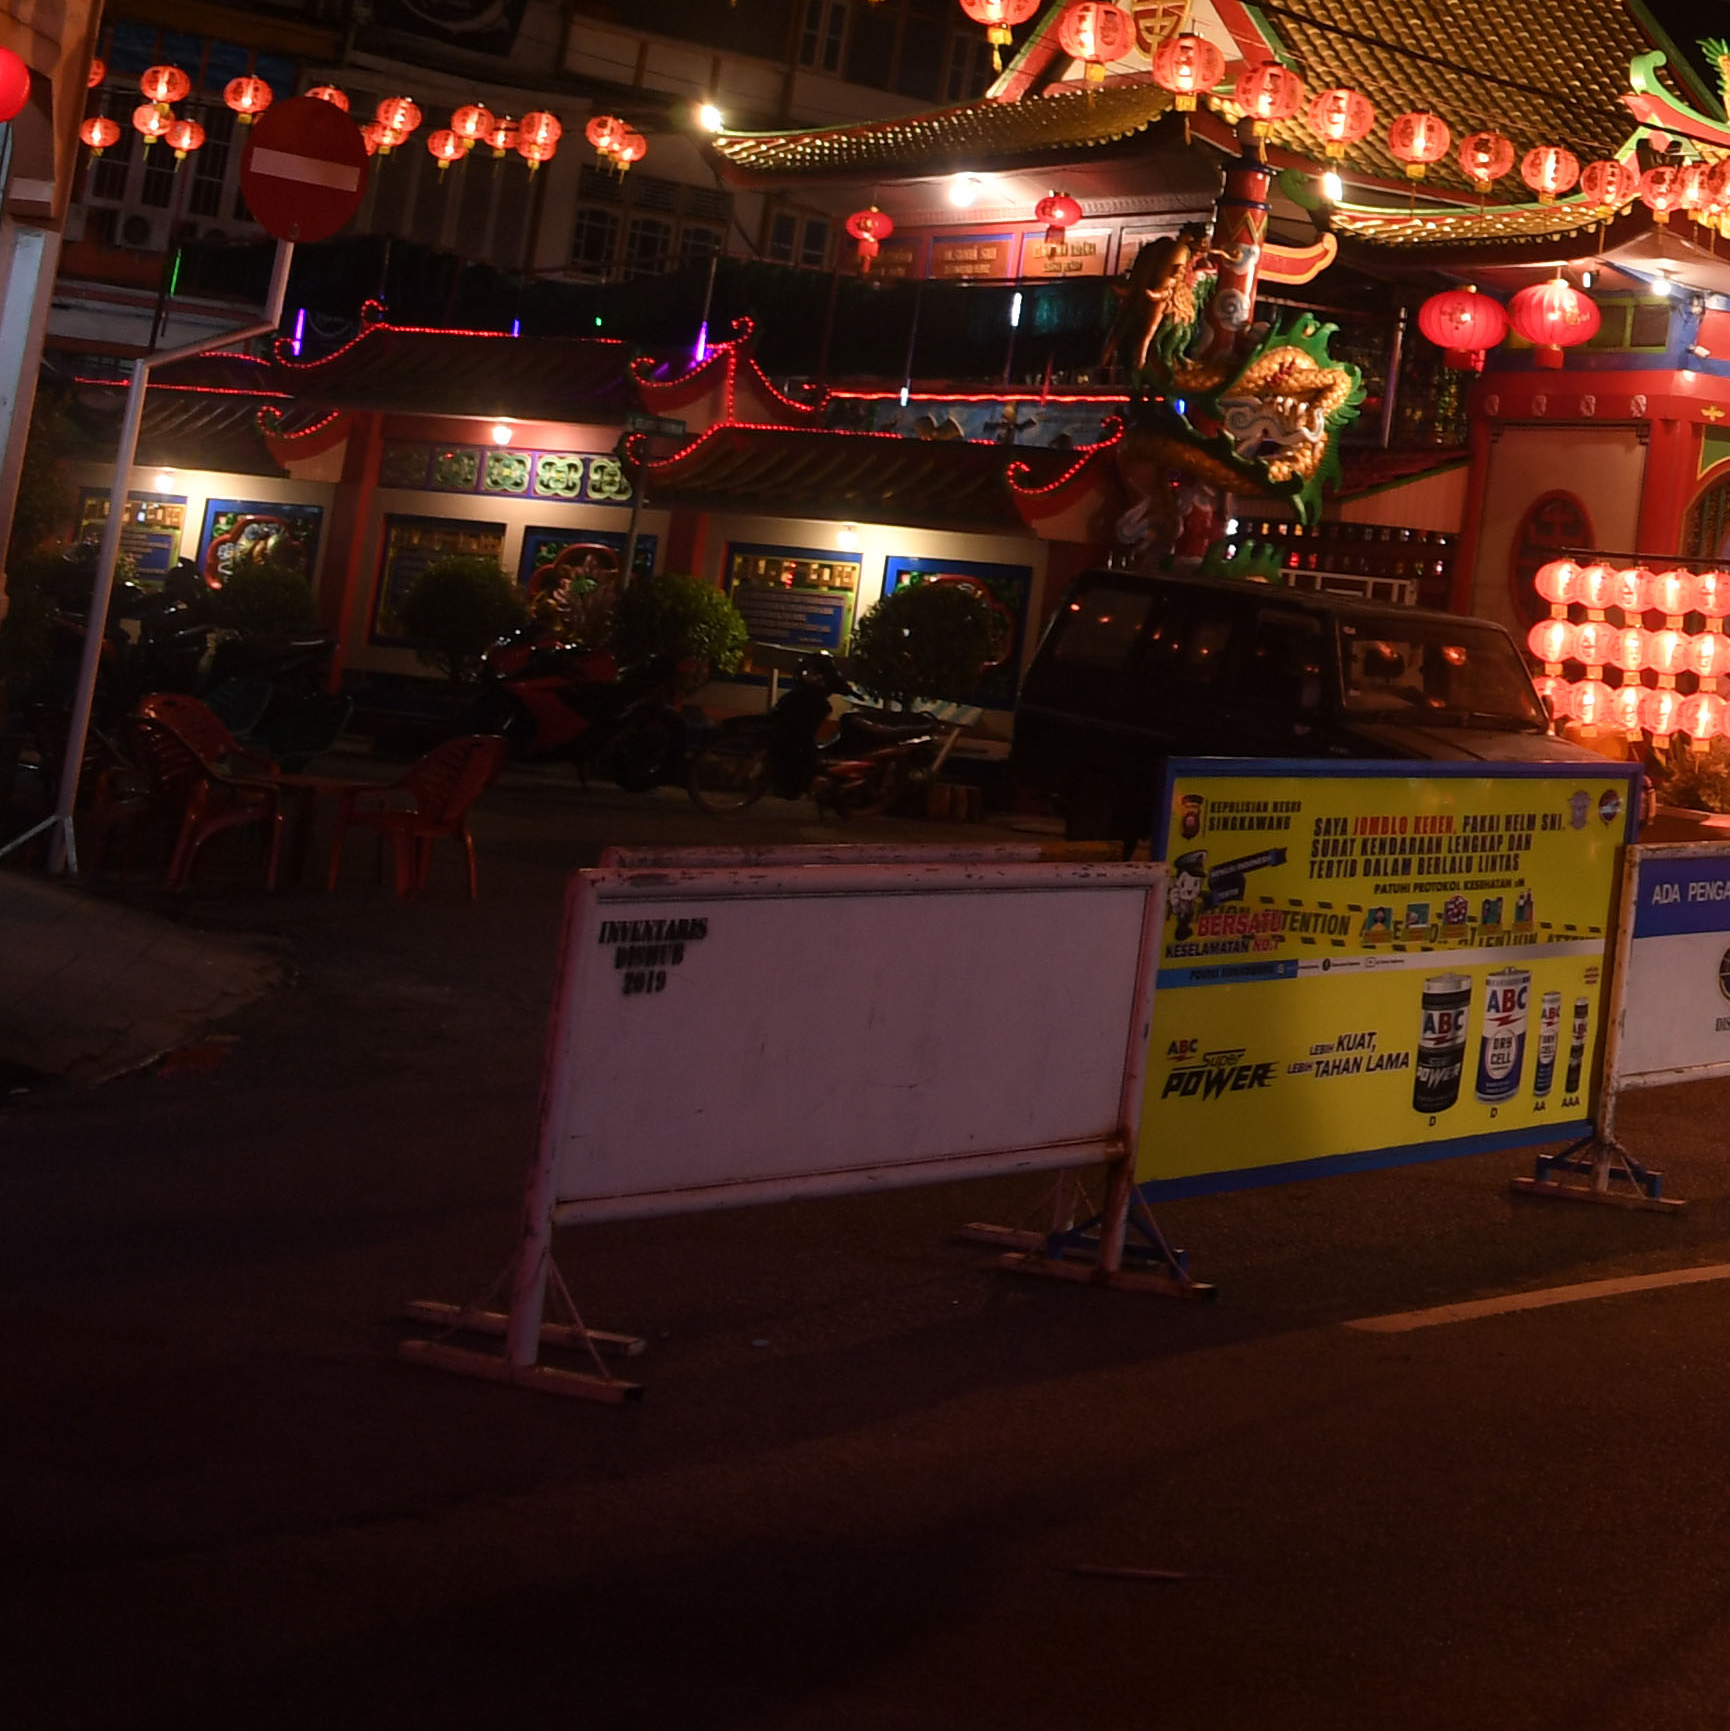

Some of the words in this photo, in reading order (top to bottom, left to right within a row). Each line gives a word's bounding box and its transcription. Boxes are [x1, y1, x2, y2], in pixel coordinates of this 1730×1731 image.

[1209, 816, 1291, 831] SINGKAWANG
[1314, 817, 1349, 837] SAYA
[1463, 814, 1500, 833] PAKAI
[1505, 814, 1536, 832] HELM
[1312, 838, 1356, 858] SURAT
[1361, 836, 1442, 856] KENDARAAN
[1448, 834, 1503, 853] LENGKAP
[1508, 833, 1532, 851] DAN
[1309, 859, 1358, 879] TERTIB
[1363, 857, 1412, 877] DALAM
[1417, 855, 1473, 875] BERLALU
[1478, 854, 1520, 872] LINTAS
[1374, 883, 1410, 894] PATUHI
[1413, 881, 1460, 893] PROTOKOL
[1652, 883, 1681, 906] ADA
[1198, 910, 1282, 937] BERSATU
[1165, 939, 1250, 959] KESELAMATAN
[1487, 986, 1528, 1013] ABC
[1423, 1010, 1464, 1034] ABC
[1167, 1039, 1199, 1056] ABC
[1310, 1043, 1335, 1056] LEBIH
[1336, 1032, 1377, 1054] KUAT,
[1492, 1036, 1512, 1050] DRY
[1315, 1056, 1363, 1078] TAHAN
[1366, 1052, 1410, 1073] LAMA
[1490, 1051, 1512, 1065] CELL
[1161, 1062, 1281, 1101] POWER
[1561, 1096, 1580, 1108] AAA
